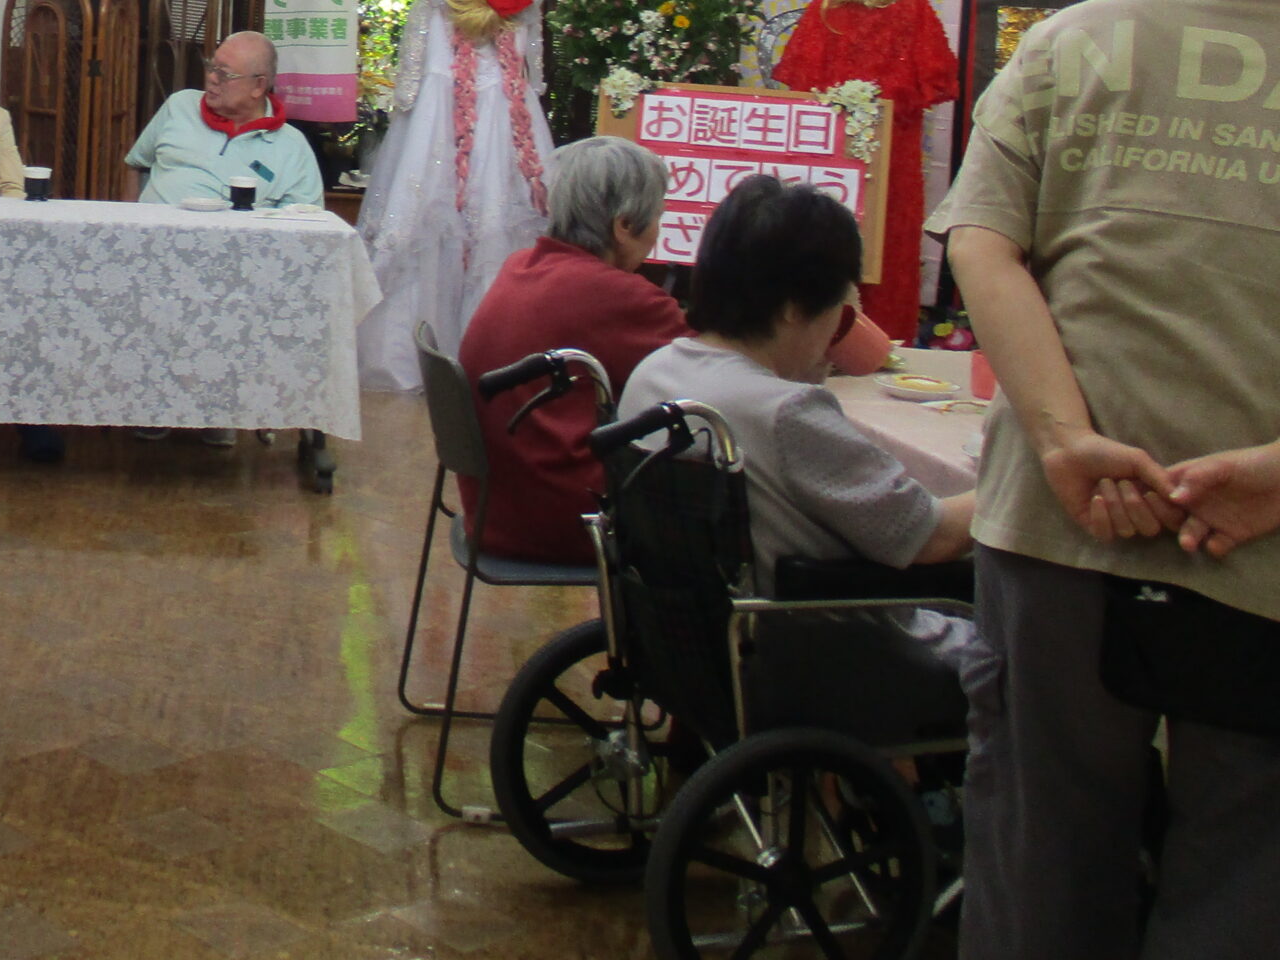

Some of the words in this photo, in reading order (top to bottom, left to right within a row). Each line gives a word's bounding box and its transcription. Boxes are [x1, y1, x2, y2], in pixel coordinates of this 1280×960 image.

[264, 17, 348, 41] 護事業者
[645, 100, 833, 150] お誕生日
[1050, 111, 1161, 139] LISHED
[1168, 116, 1206, 141] IN
[1059, 143, 1248, 182] CALIFORNIA
